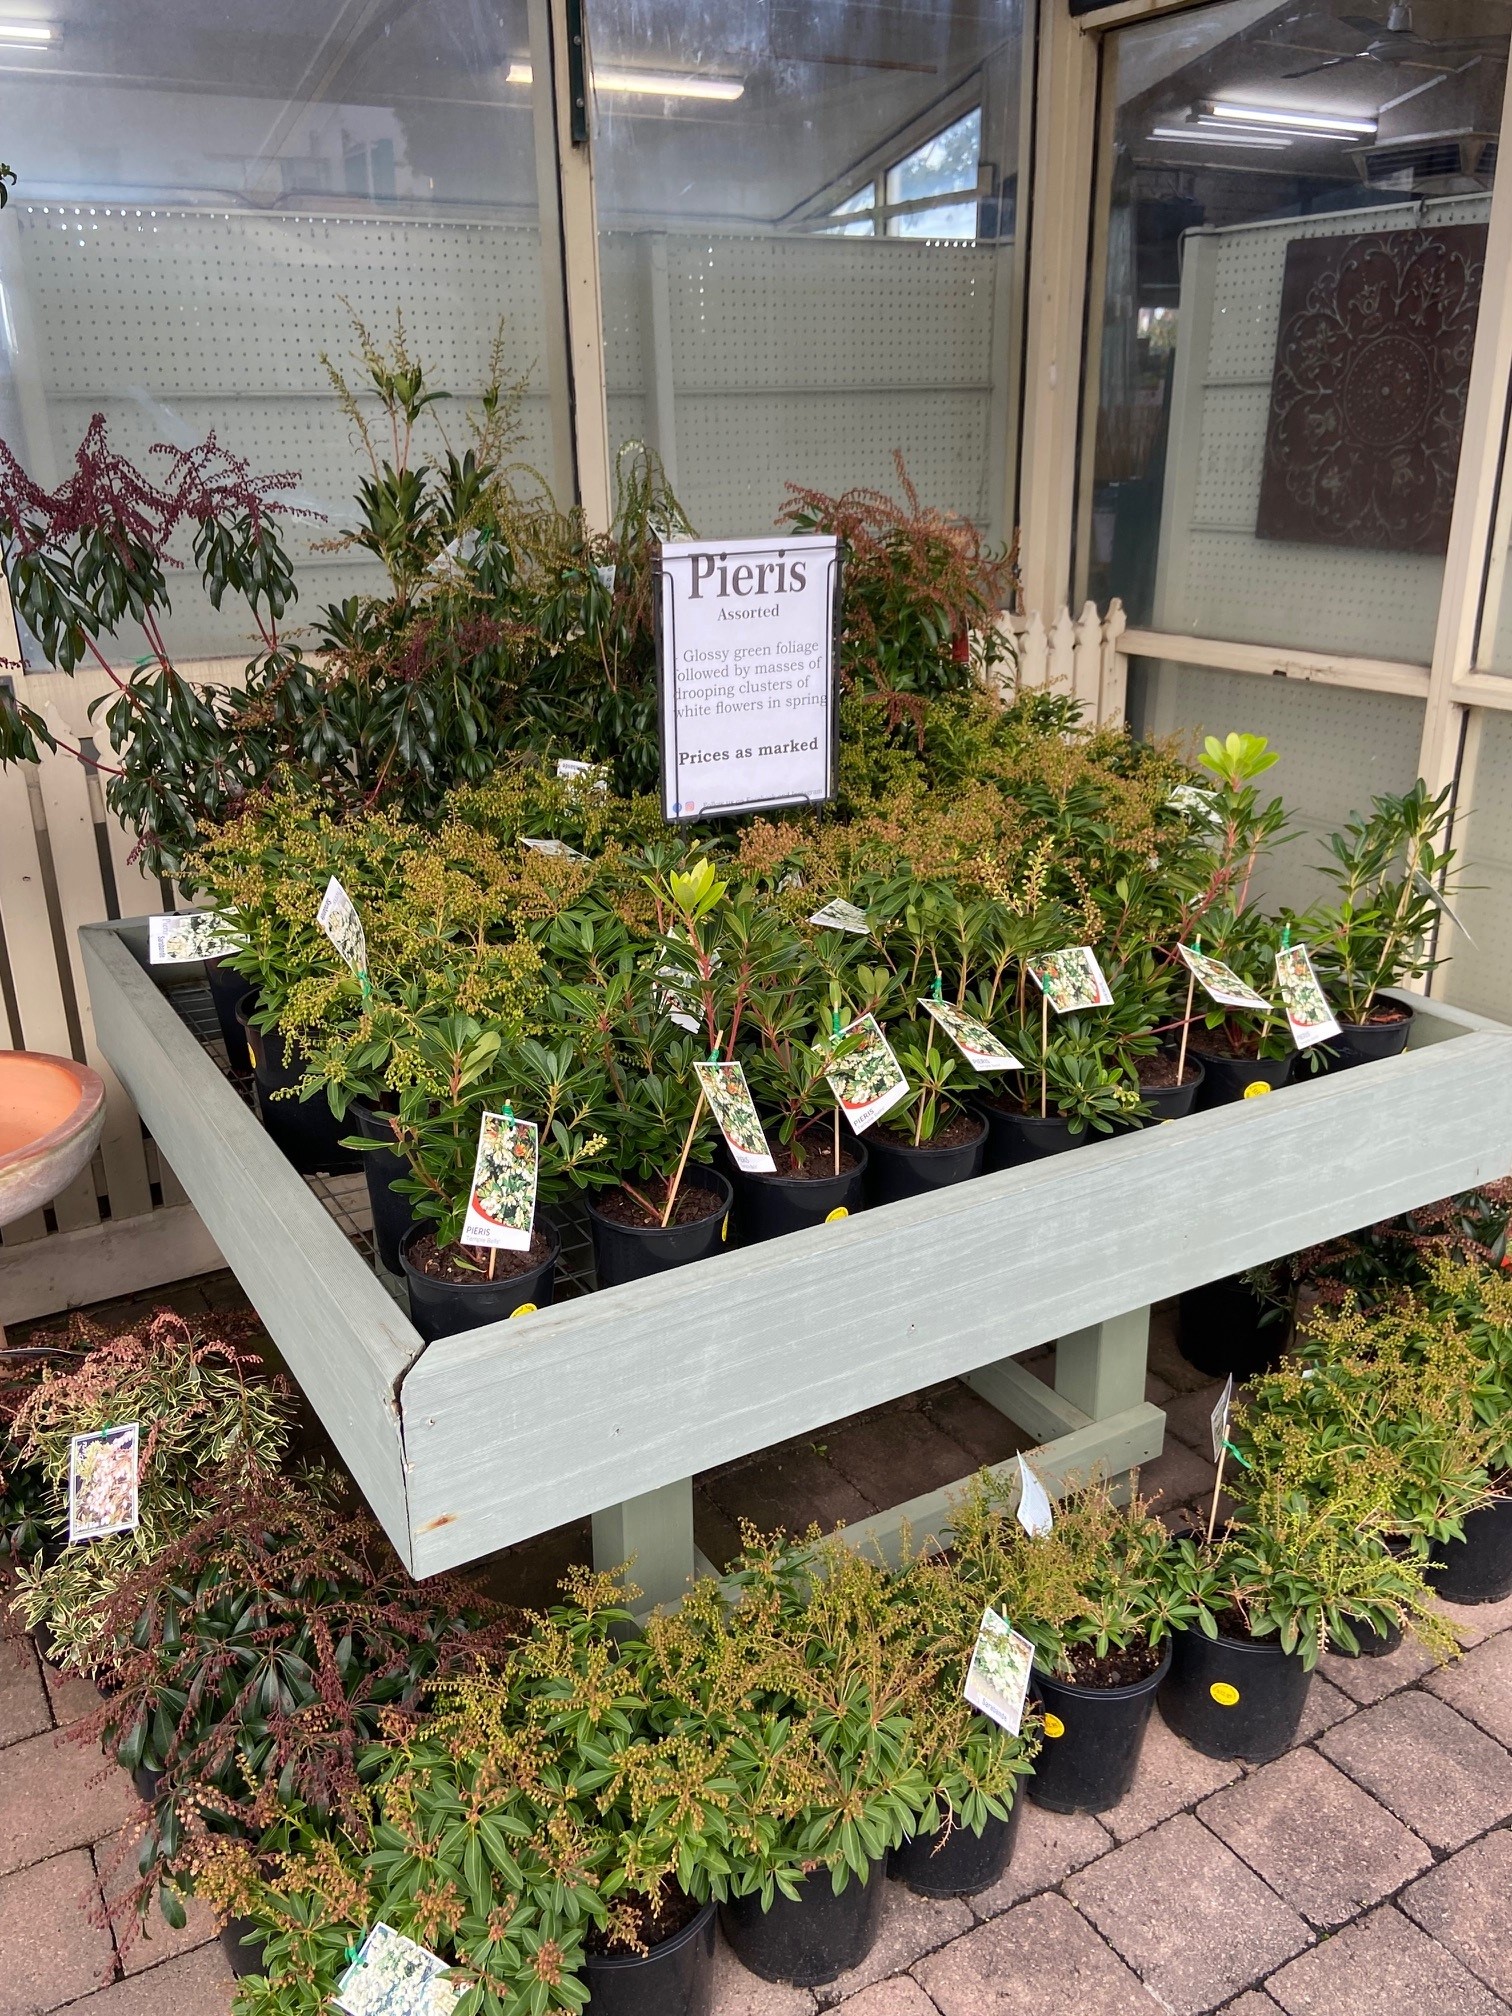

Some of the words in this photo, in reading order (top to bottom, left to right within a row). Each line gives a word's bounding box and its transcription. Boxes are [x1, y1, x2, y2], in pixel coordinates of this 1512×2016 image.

[688, 549, 807, 600] Pieris
[717, 604, 780, 621] Assorted
[683, 649, 730, 663] Glossy
[734, 645, 771, 661] green
[776, 640, 819, 656] foliage
[734, 664, 750, 679] by
[755, 661, 804, 675] masses
[809, 656, 822, 669] of
[739, 681, 793, 694] clusters
[797, 675, 811, 688] of
[716, 701, 764, 715] flowers
[768, 697, 781, 709] in
[785, 693, 828, 710] spring
[679, 749, 730, 766] Prices
[735, 747, 753, 759] as
[758, 736, 819, 757] marked
[853, 1108, 875, 1127] PIERIS
[466, 1226, 491, 1236] PIERIS
